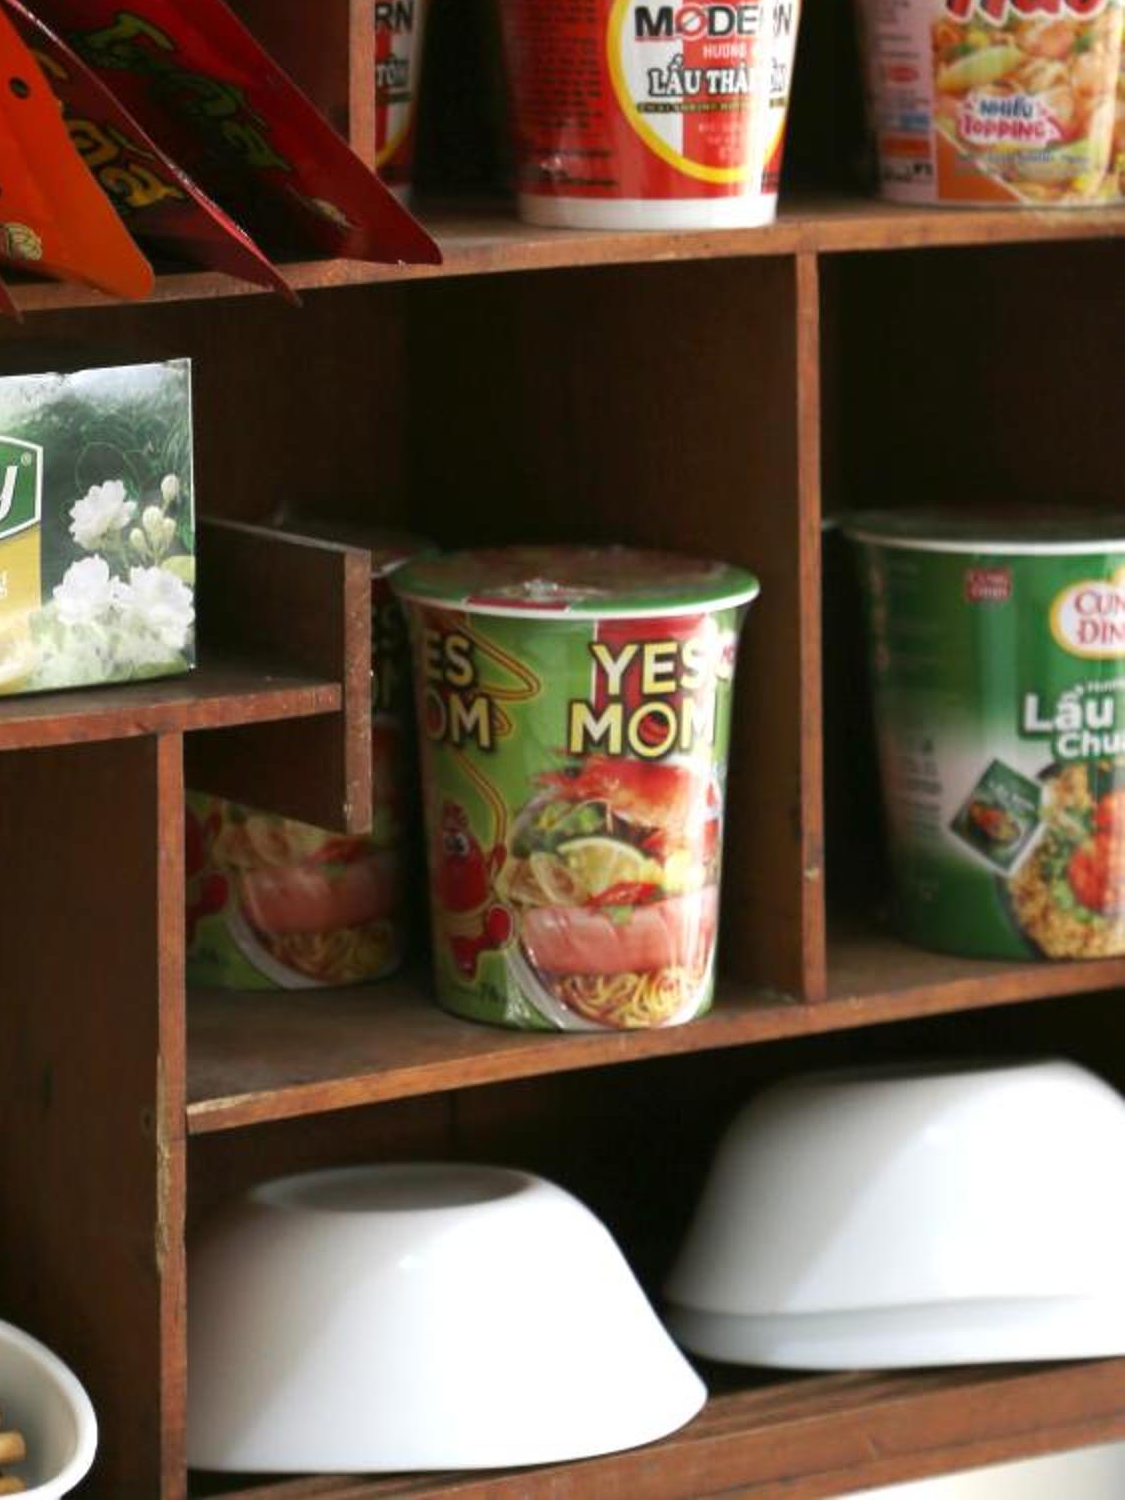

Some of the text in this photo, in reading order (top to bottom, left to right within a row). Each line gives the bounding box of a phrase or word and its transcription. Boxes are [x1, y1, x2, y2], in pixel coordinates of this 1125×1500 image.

[634, 3, 793, 41] MODEN
[426, 631, 475, 686] ES
[591, 638, 707, 697] YES
[426, 690, 491, 749] OM
[570, 697, 715, 758] MOM
